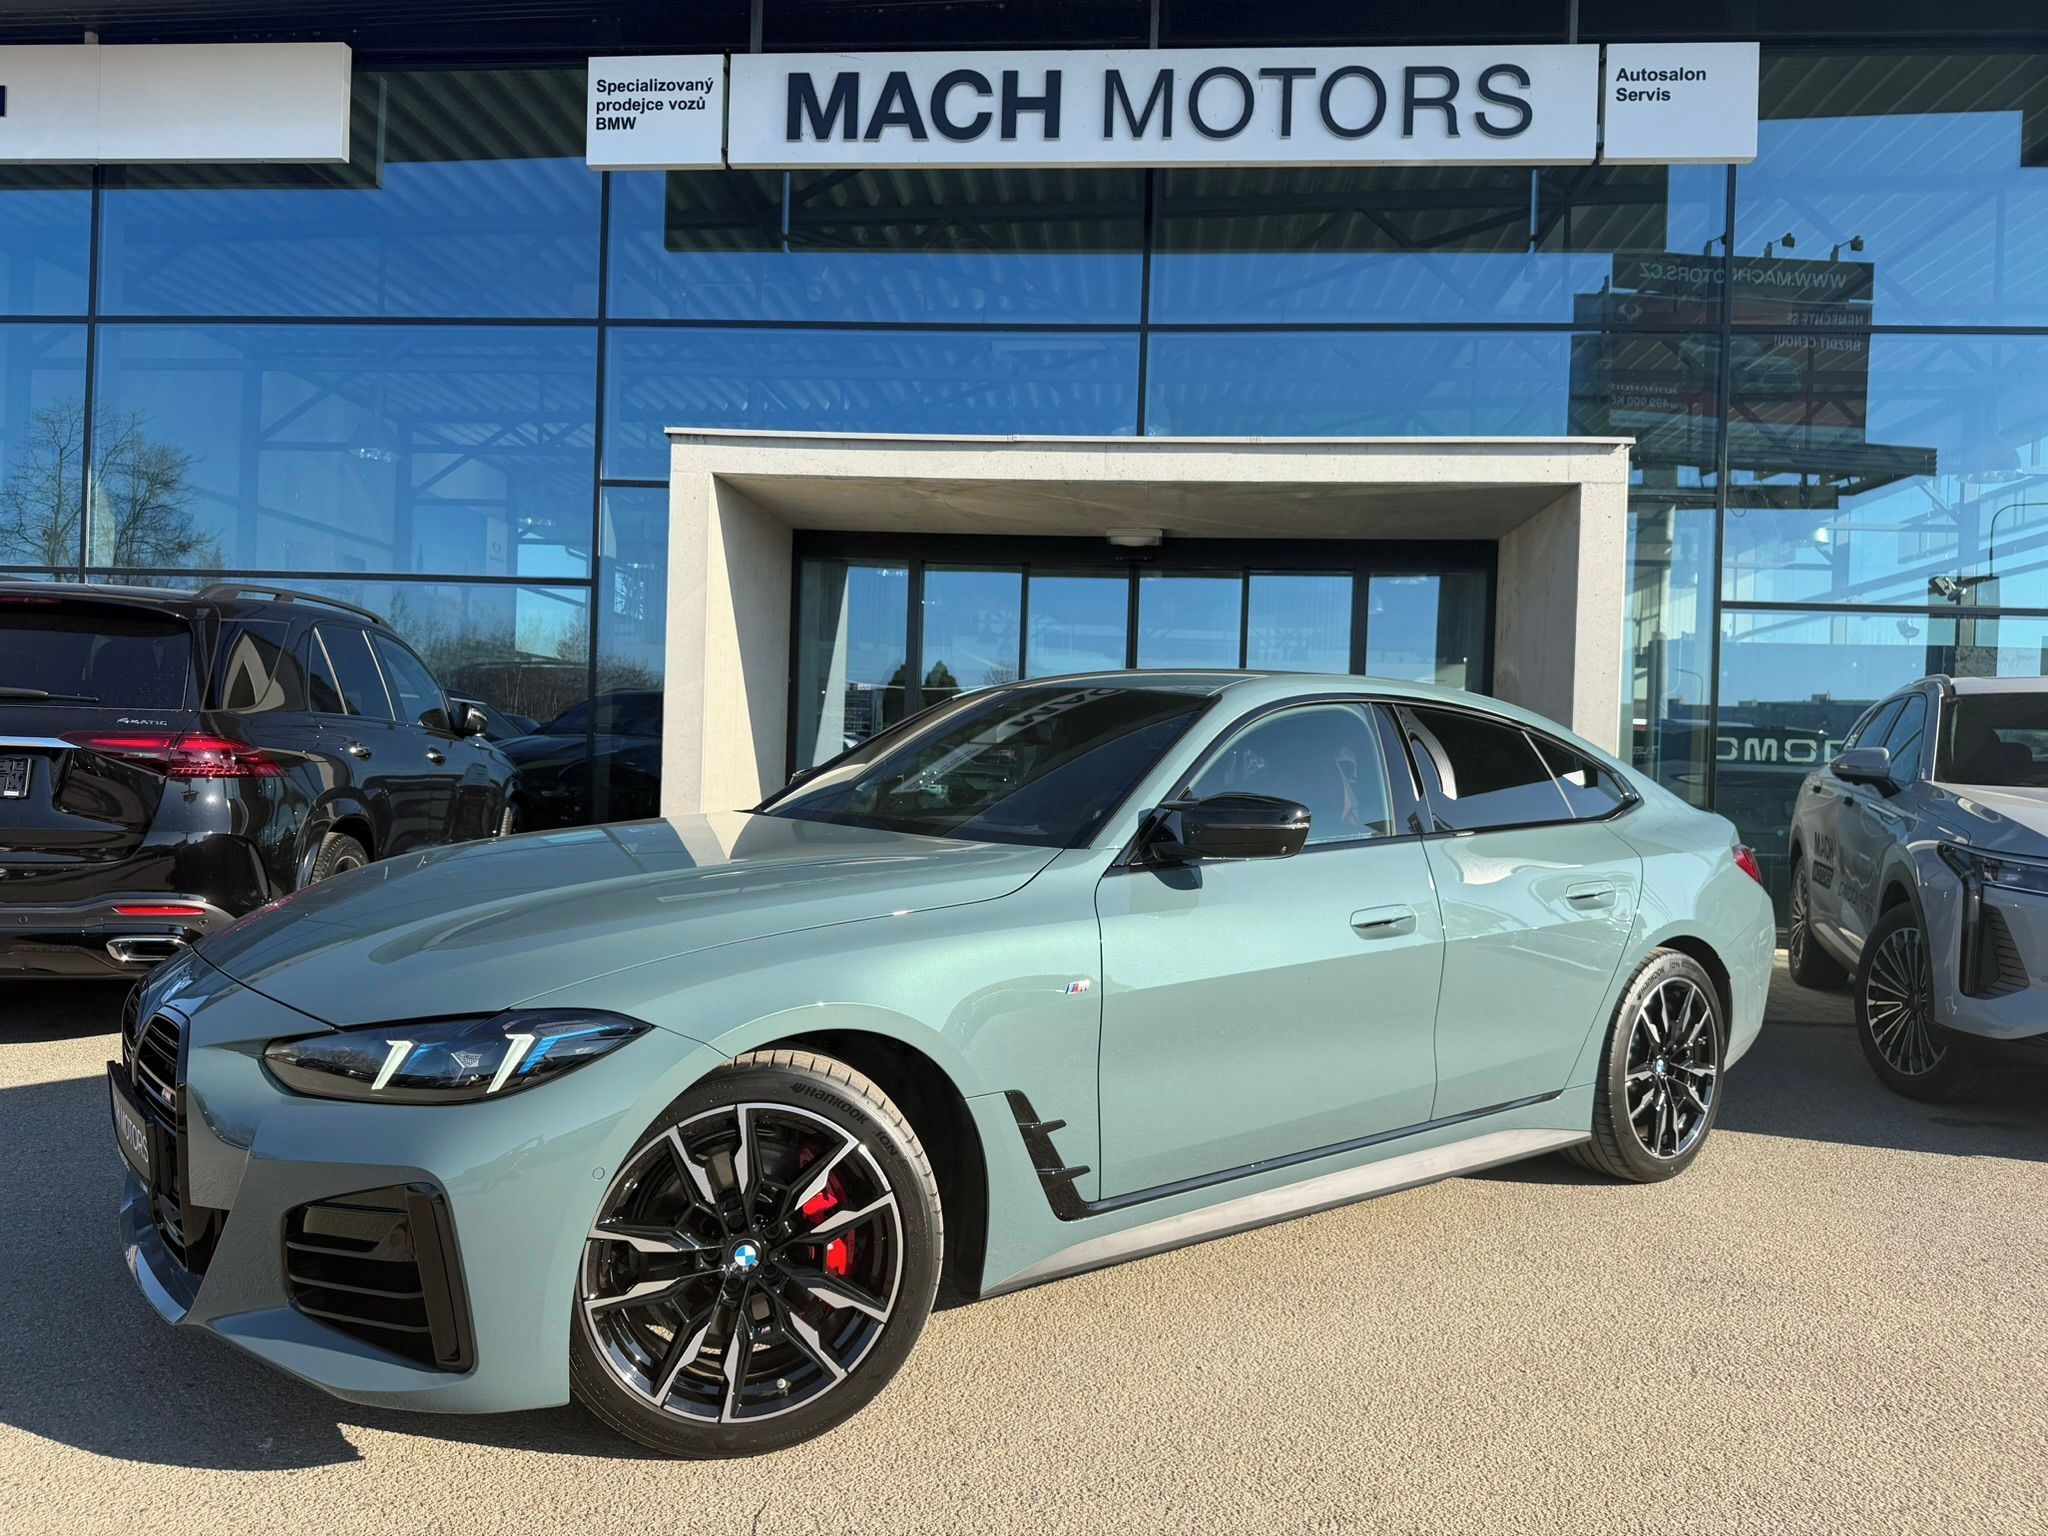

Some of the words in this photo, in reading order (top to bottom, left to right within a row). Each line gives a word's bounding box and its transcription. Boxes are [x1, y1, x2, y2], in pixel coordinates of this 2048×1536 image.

[1616, 67, 1707, 82] Autosalon
[596, 77, 714, 95] Specializovaný
[1616, 87, 1671, 102] Servis
[596, 98, 664, 114] prodejce
[668, 96, 706, 111] vozů
[786, 68, 1063, 142] MACH
[1103, 64, 1535, 140] MOTORS
[596, 116, 636, 130] BMW
[117, 717, 168, 726] 4MATIC
